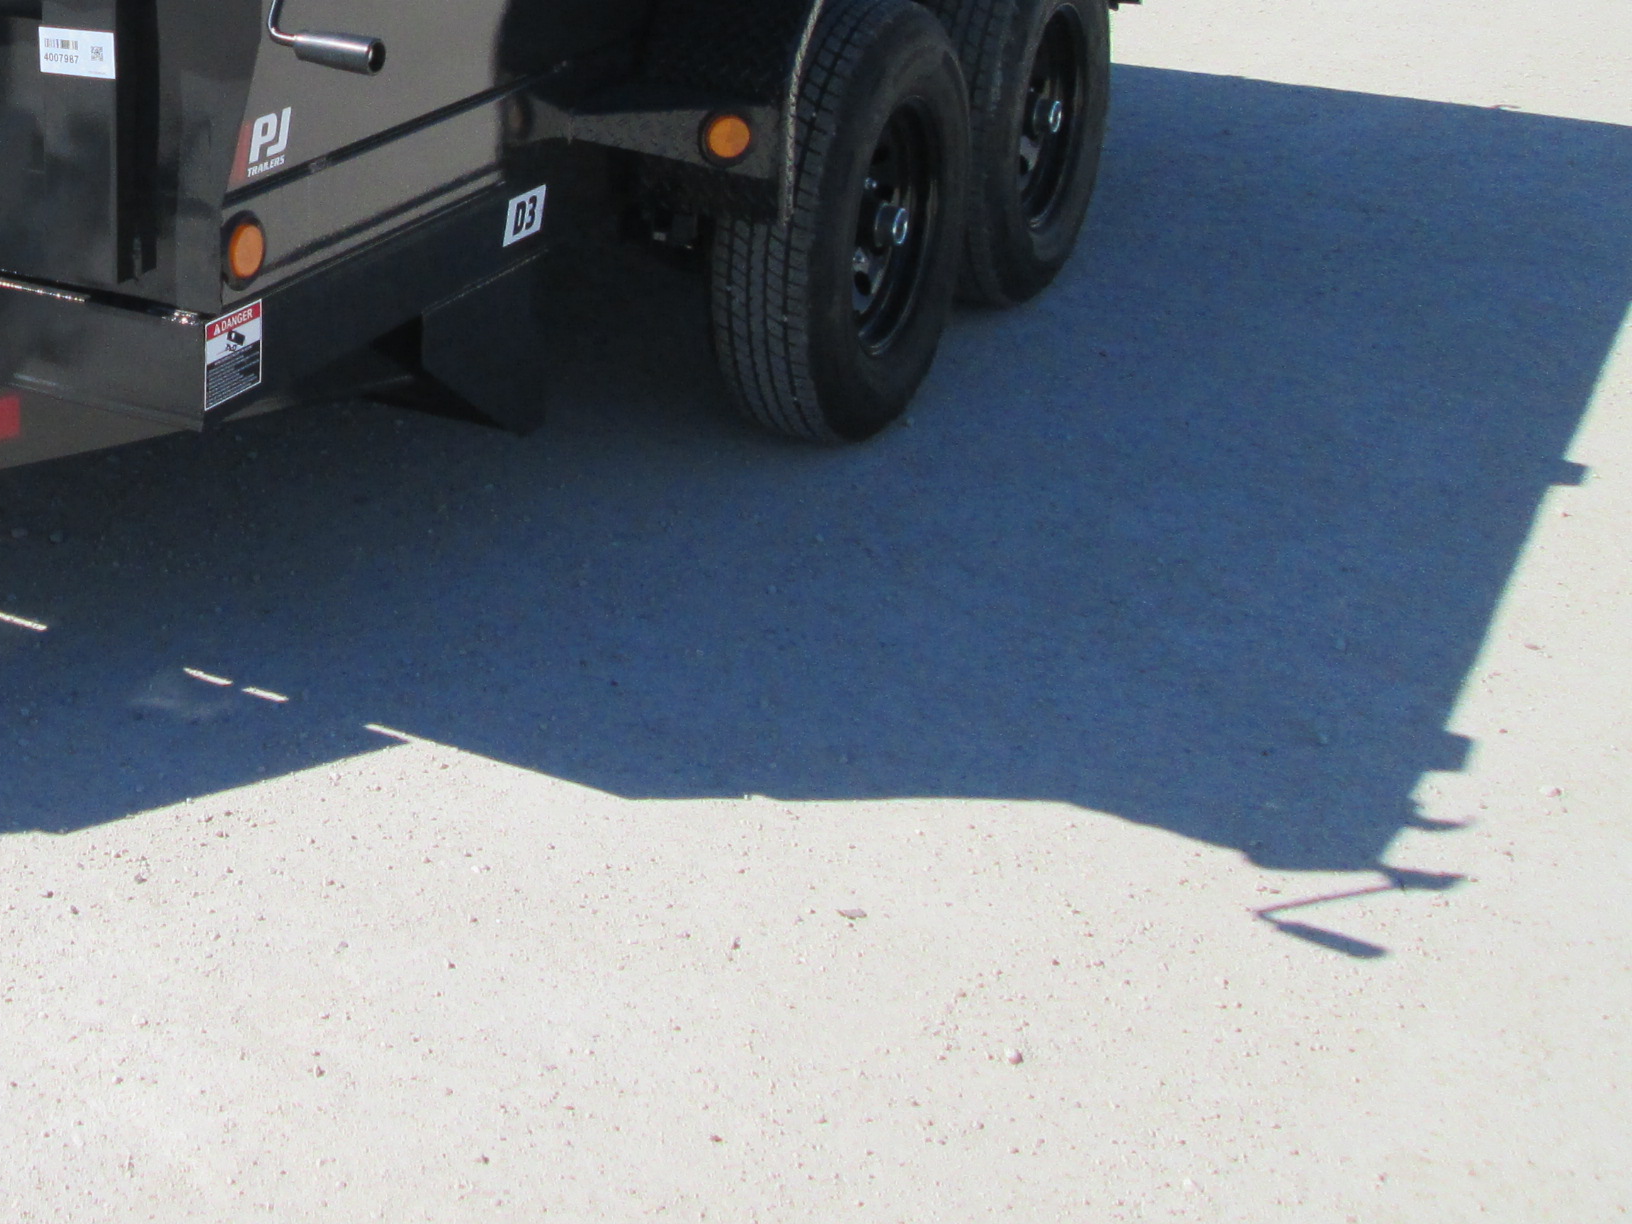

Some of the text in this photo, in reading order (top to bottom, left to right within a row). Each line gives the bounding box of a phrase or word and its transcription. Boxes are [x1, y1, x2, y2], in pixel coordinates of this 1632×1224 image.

[44, 52, 79, 65] 4007987
[249, 106, 292, 165] PJ
[247, 155, 285, 178] TRAILERS
[513, 195, 537, 236] D3
[220, 308, 254, 333] DANGER
